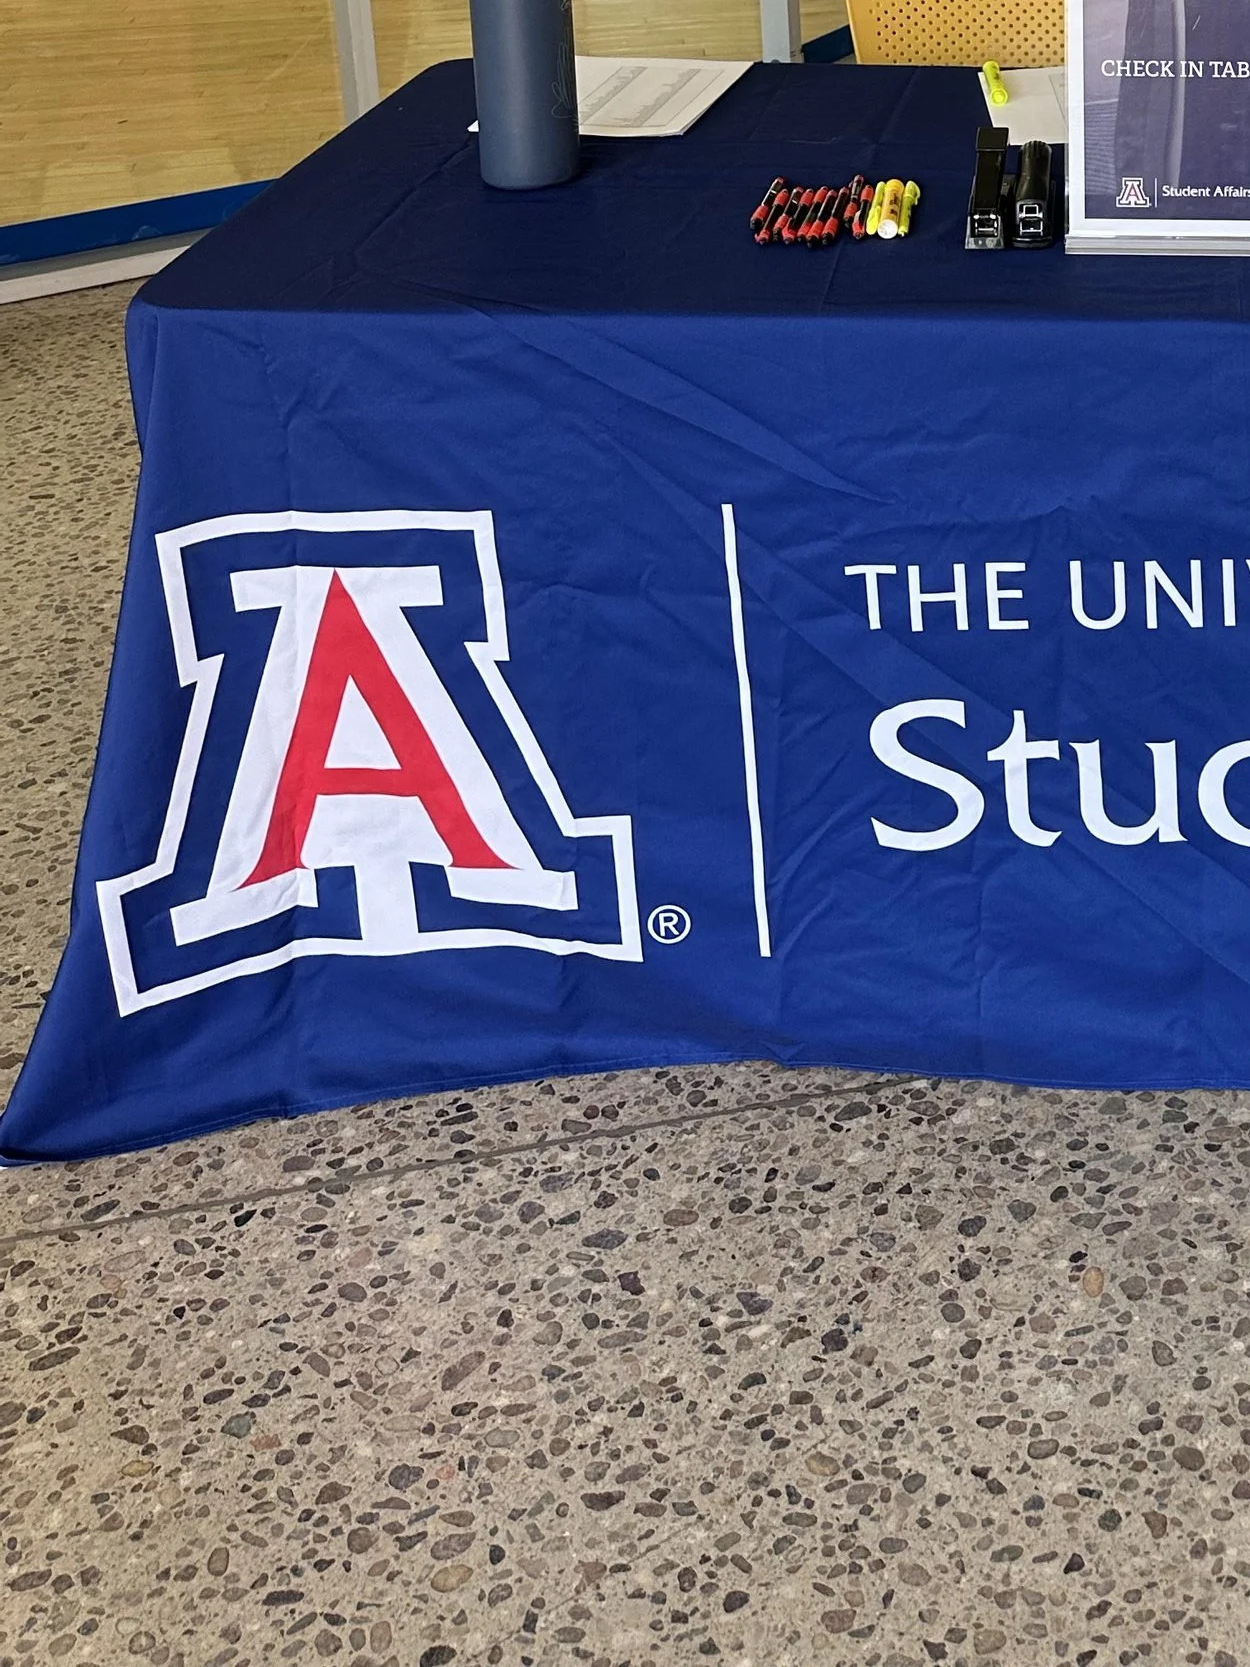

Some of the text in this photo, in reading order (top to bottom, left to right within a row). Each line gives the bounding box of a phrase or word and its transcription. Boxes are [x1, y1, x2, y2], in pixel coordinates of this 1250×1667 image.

[1101, 60, 1175, 78] CHECK
[1179, 61, 1206, 78] IN
[1116, 177, 1150, 208] A
[1162, 185, 1211, 197] Student
[843, 560, 1031, 632] THE
[96, 510, 643, 1018] A
